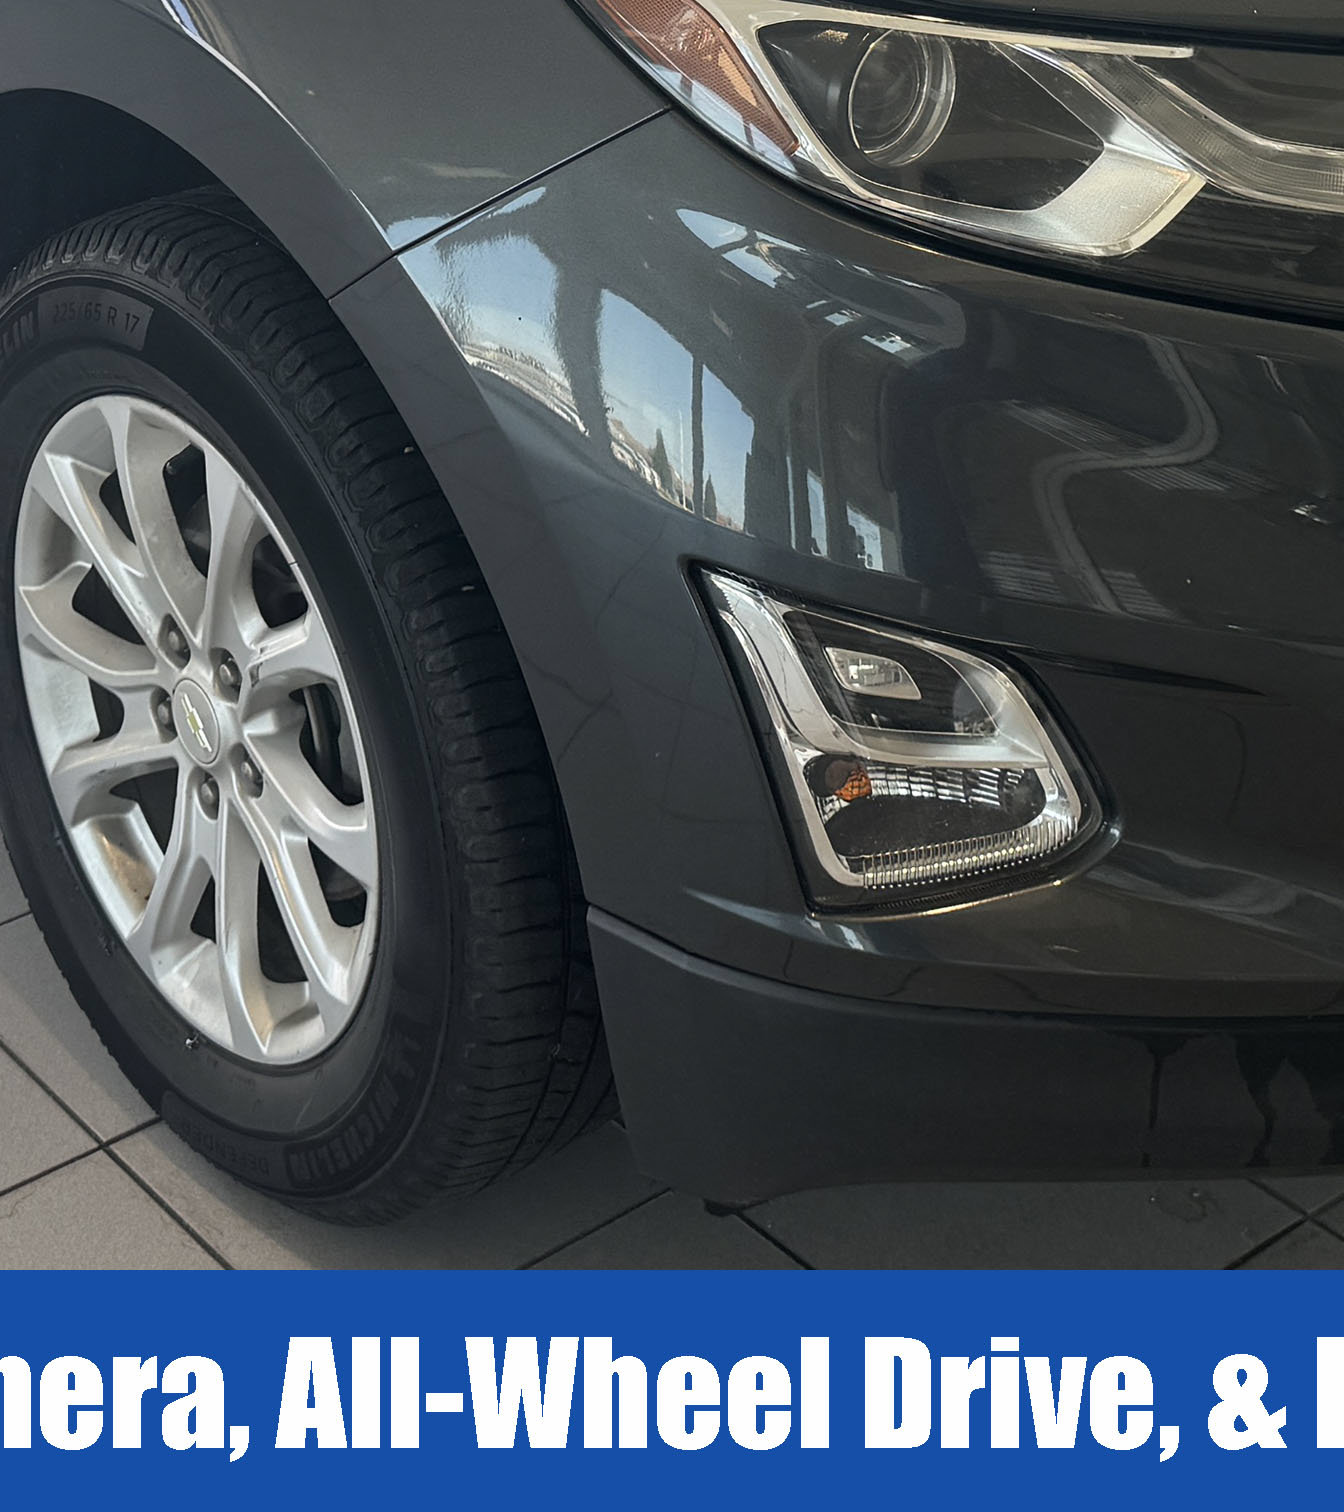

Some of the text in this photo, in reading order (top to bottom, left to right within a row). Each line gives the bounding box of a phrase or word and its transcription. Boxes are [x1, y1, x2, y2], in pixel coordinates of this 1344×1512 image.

[52, 301, 141, 335] 225/65 R 17
